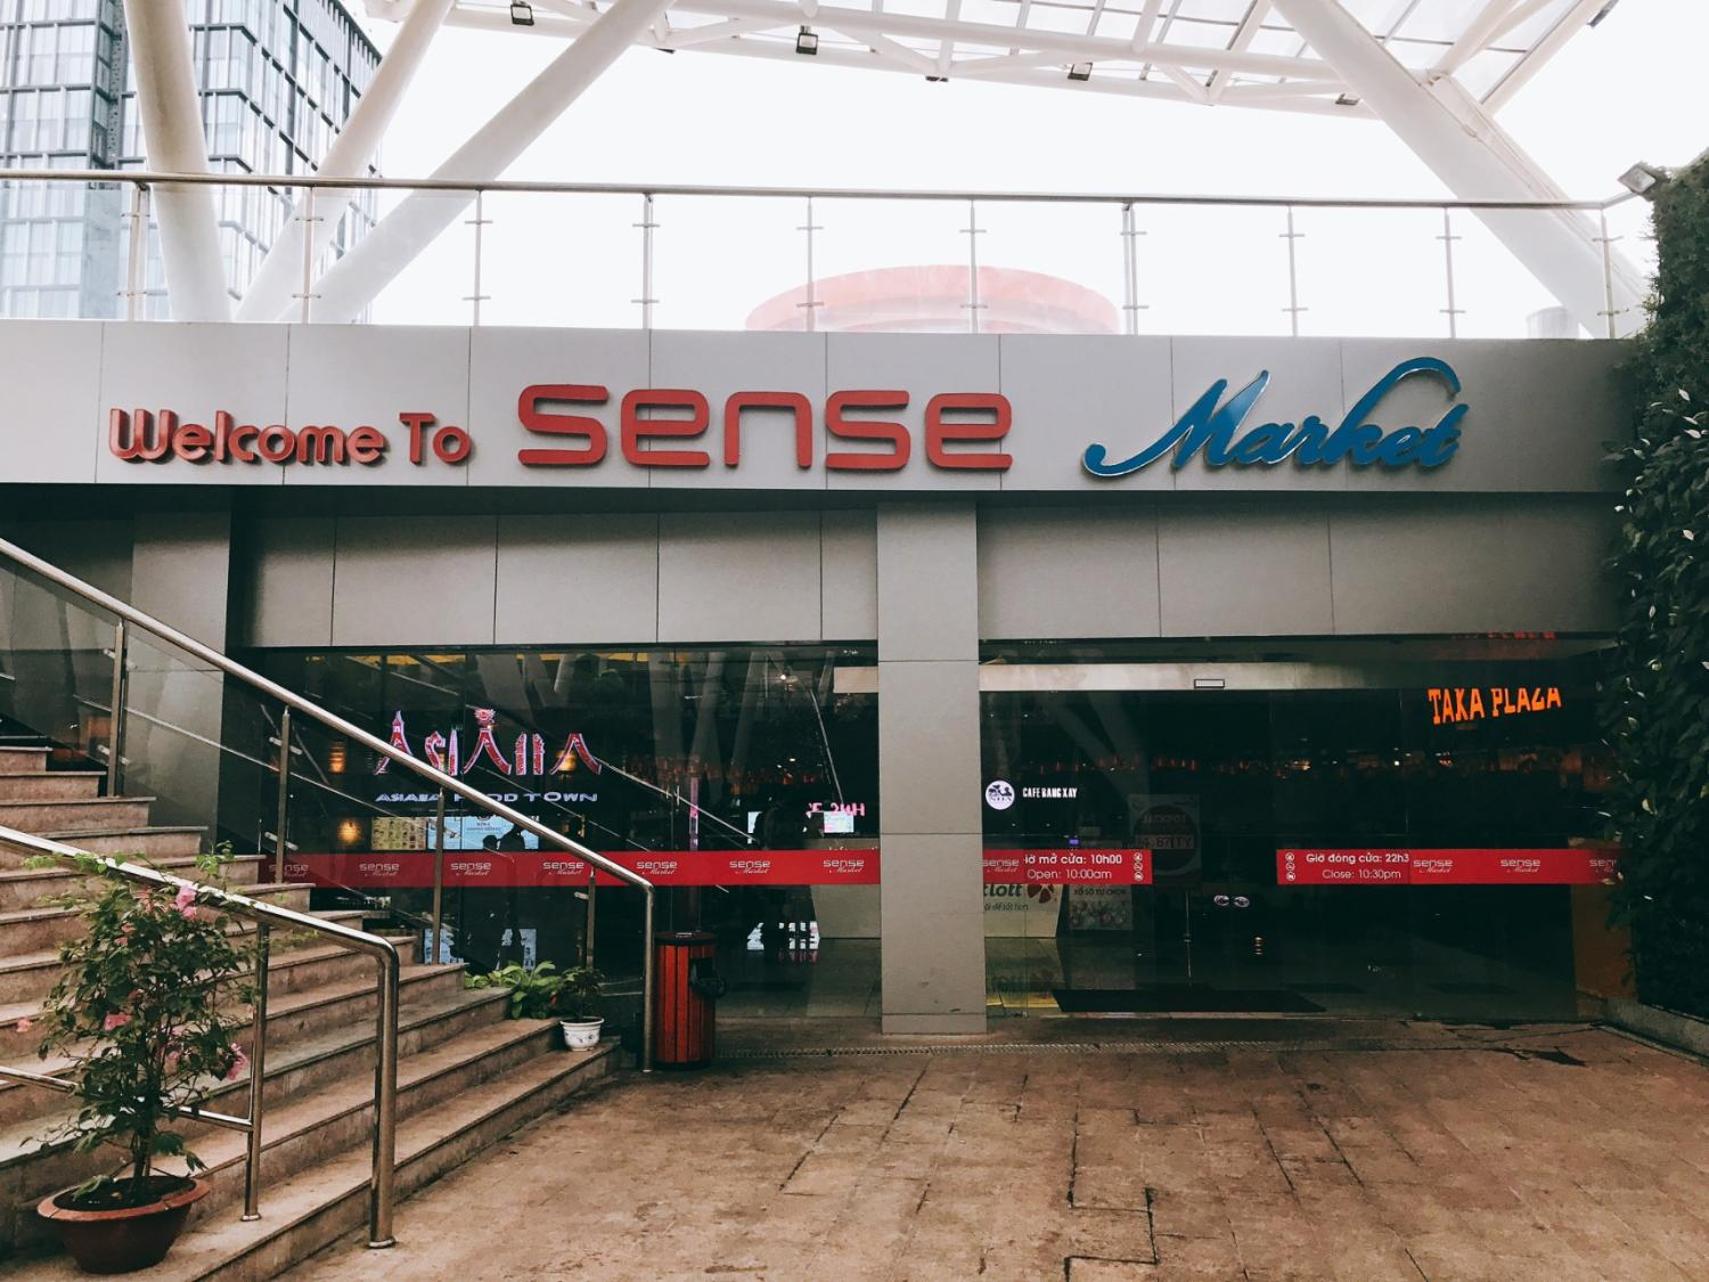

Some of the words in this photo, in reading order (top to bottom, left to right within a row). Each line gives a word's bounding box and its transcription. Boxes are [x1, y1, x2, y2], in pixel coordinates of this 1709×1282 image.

[109, 407, 385, 464] Welcome
[399, 411, 473, 465] To
[1080, 356, 1469, 477] Market
[1427, 687, 1486, 725] TAKA
[1490, 686, 1562, 718] PLAZA
[523, 791, 599, 803] TOWN
[1022, 787, 1040, 799] CAFE
[1062, 787, 1078, 799] XAY
[1039, 852, 1058, 865] mở
[1091, 853, 1123, 865] 10h00
[1306, 852, 1324, 864] Giờ
[1027, 868, 1061, 880] Open:
[1066, 868, 1113, 879] 10:00am
[1322, 869, 1354, 880] Close:
[1359, 868, 1401, 881] 10:30pm
